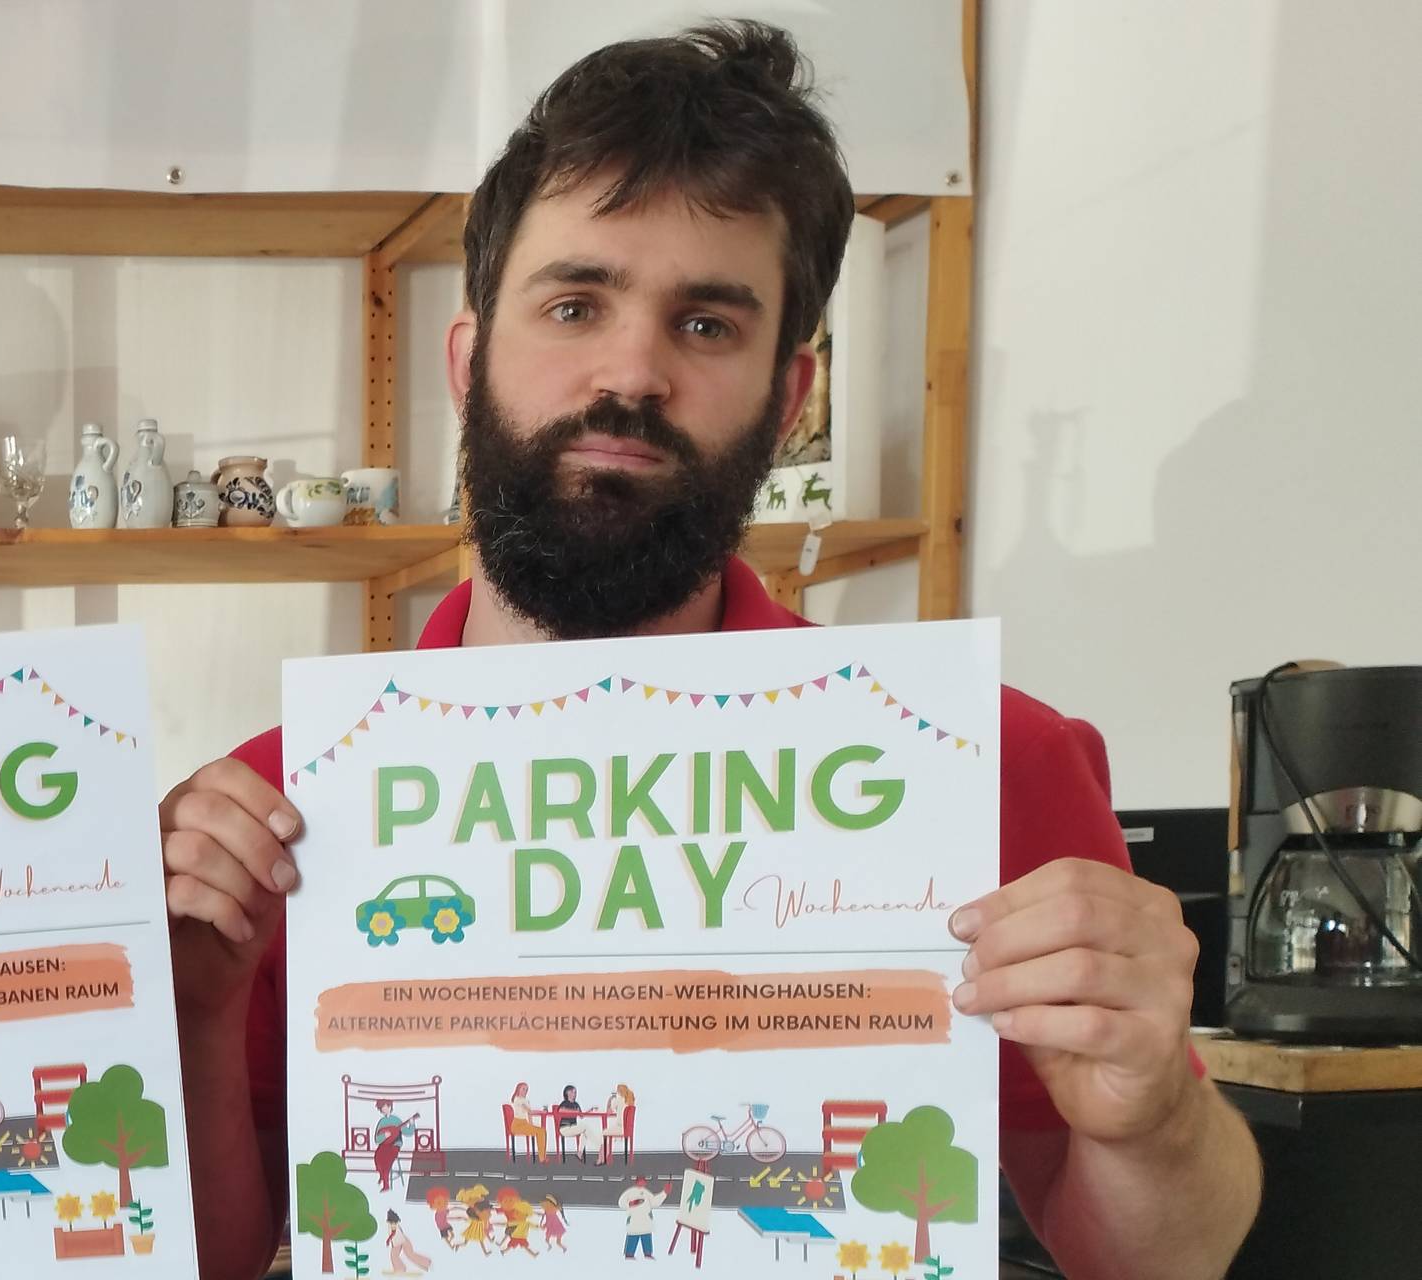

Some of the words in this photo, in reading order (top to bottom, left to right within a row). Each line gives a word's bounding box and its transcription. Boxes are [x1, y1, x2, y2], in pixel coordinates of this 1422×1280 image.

[374, 745, 905, 846] PARKING
[512, 840, 747, 932] DAY
[66, 981, 119, 1001] RAUM
[383, 986, 412, 1001] EIN
[419, 984, 558, 1001] WOCHENENDE
[565, 984, 586, 1000] IN
[592, 982, 872, 1000] HAGEN-WEHRINGHAUSEN:
[328, 1015, 444, 1031] ALTERNATIVE
[451, 1010, 717, 1031] PARKFLÄCHENGESTALTUNG
[725, 1015, 750, 1030] IM
[757, 1014, 861, 1031] URBANEN
[868, 1014, 934, 1030] RAUM
